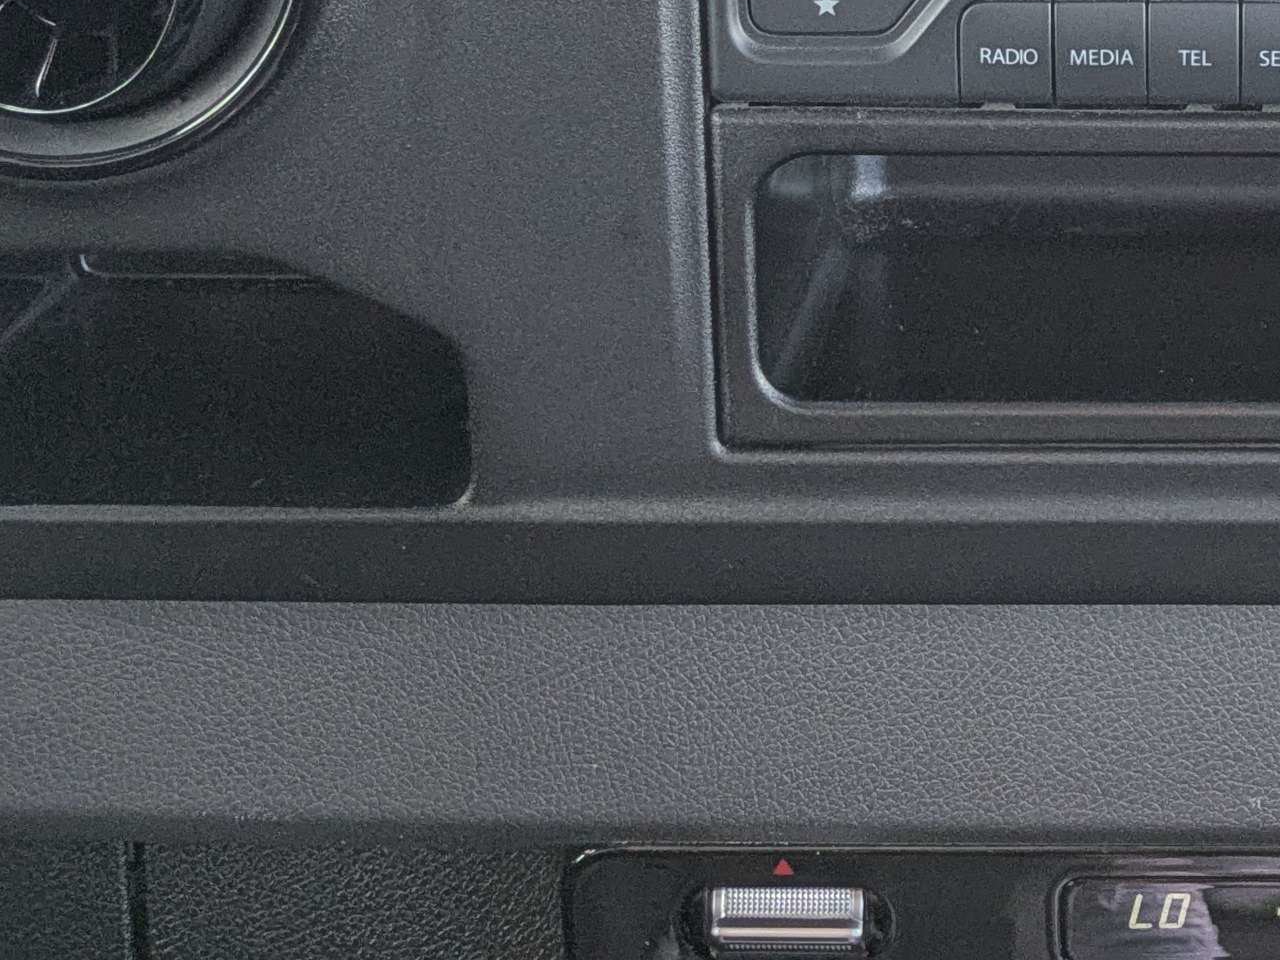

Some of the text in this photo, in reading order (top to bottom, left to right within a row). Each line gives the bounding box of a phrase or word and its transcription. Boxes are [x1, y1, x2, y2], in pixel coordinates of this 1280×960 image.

[979, 47, 1038, 64] RADIO
[1070, 49, 1133, 66] MEDIA
[1178, 49, 1211, 66] TEL
[1129, 893, 1191, 929] LO
